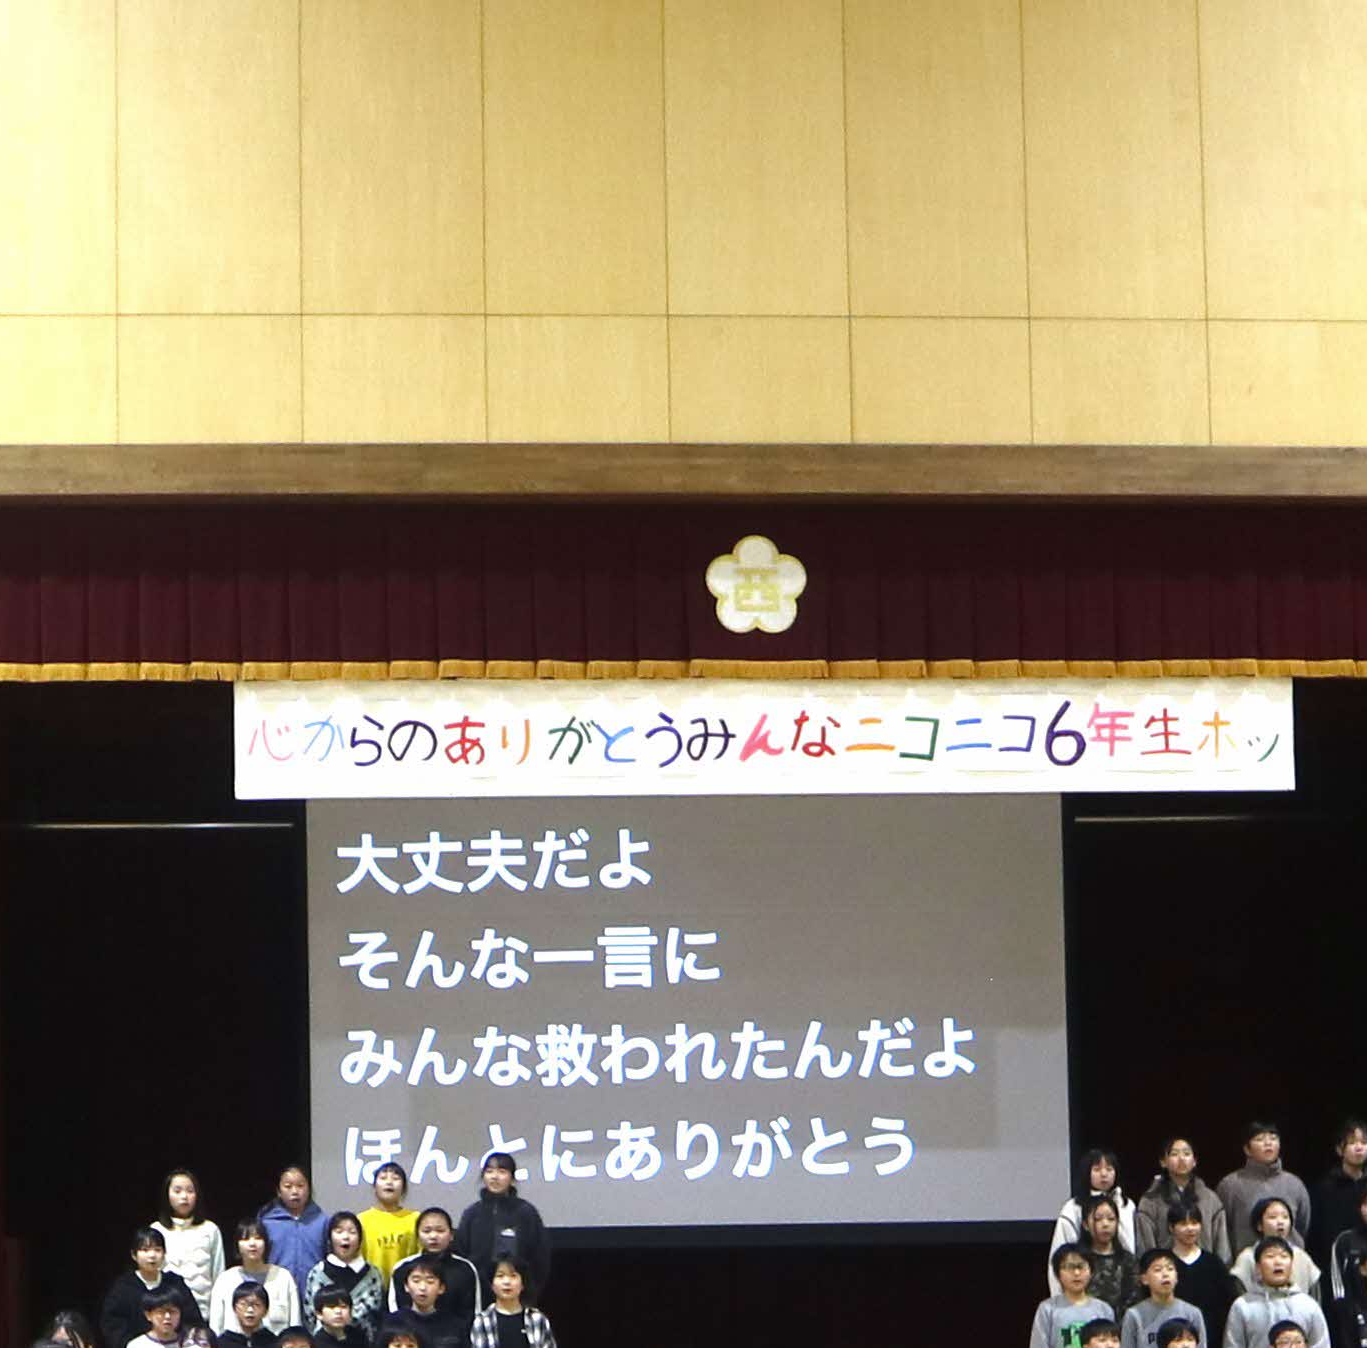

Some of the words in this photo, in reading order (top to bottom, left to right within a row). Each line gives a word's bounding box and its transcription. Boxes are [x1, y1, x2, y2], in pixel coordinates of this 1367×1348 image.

[248, 700, 1279, 767] 心からのありがとうみんなニコニコ6年生ホッ
[336, 827, 653, 895] 大丈夫だよ
[338, 925, 721, 990] そんな一言に
[339, 1017, 977, 1089] みんな救われたんだよ
[343, 1115, 916, 1187] ほんとにありがとう
